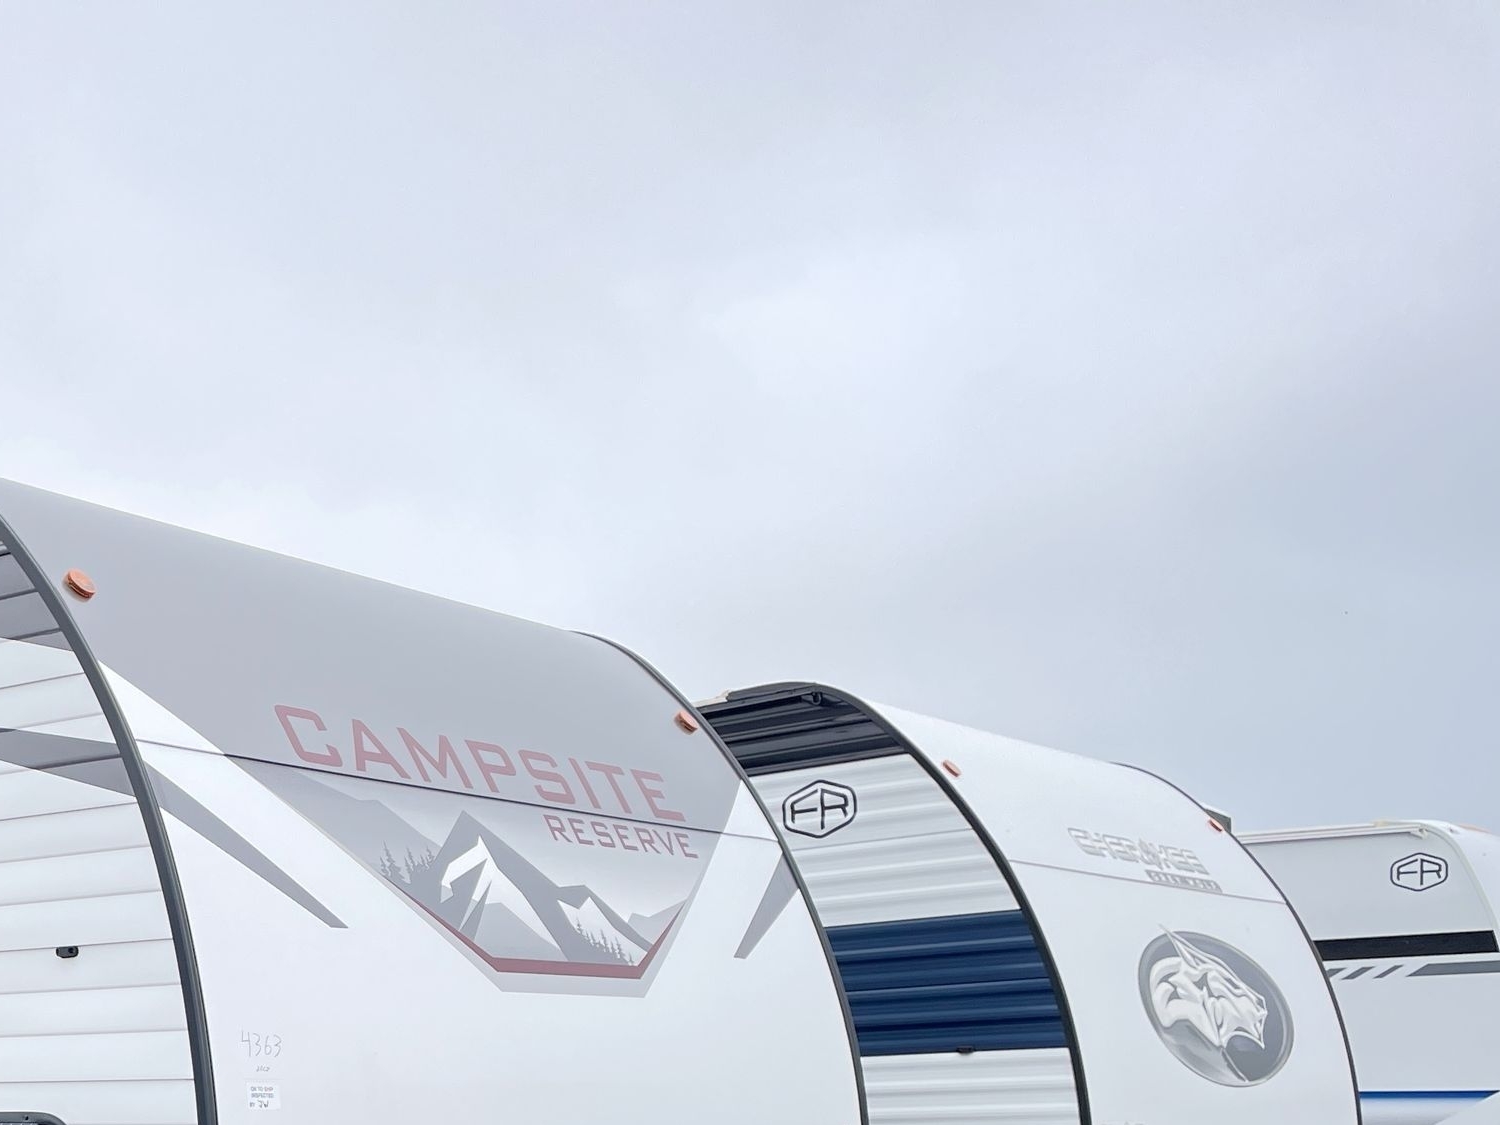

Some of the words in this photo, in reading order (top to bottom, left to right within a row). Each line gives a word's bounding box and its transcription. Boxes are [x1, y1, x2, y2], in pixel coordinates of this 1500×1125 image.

[273, 704, 686, 822] CAMPSITE
[543, 814, 699, 859] RESERVE
[241, 1030, 282, 1058] 4363
